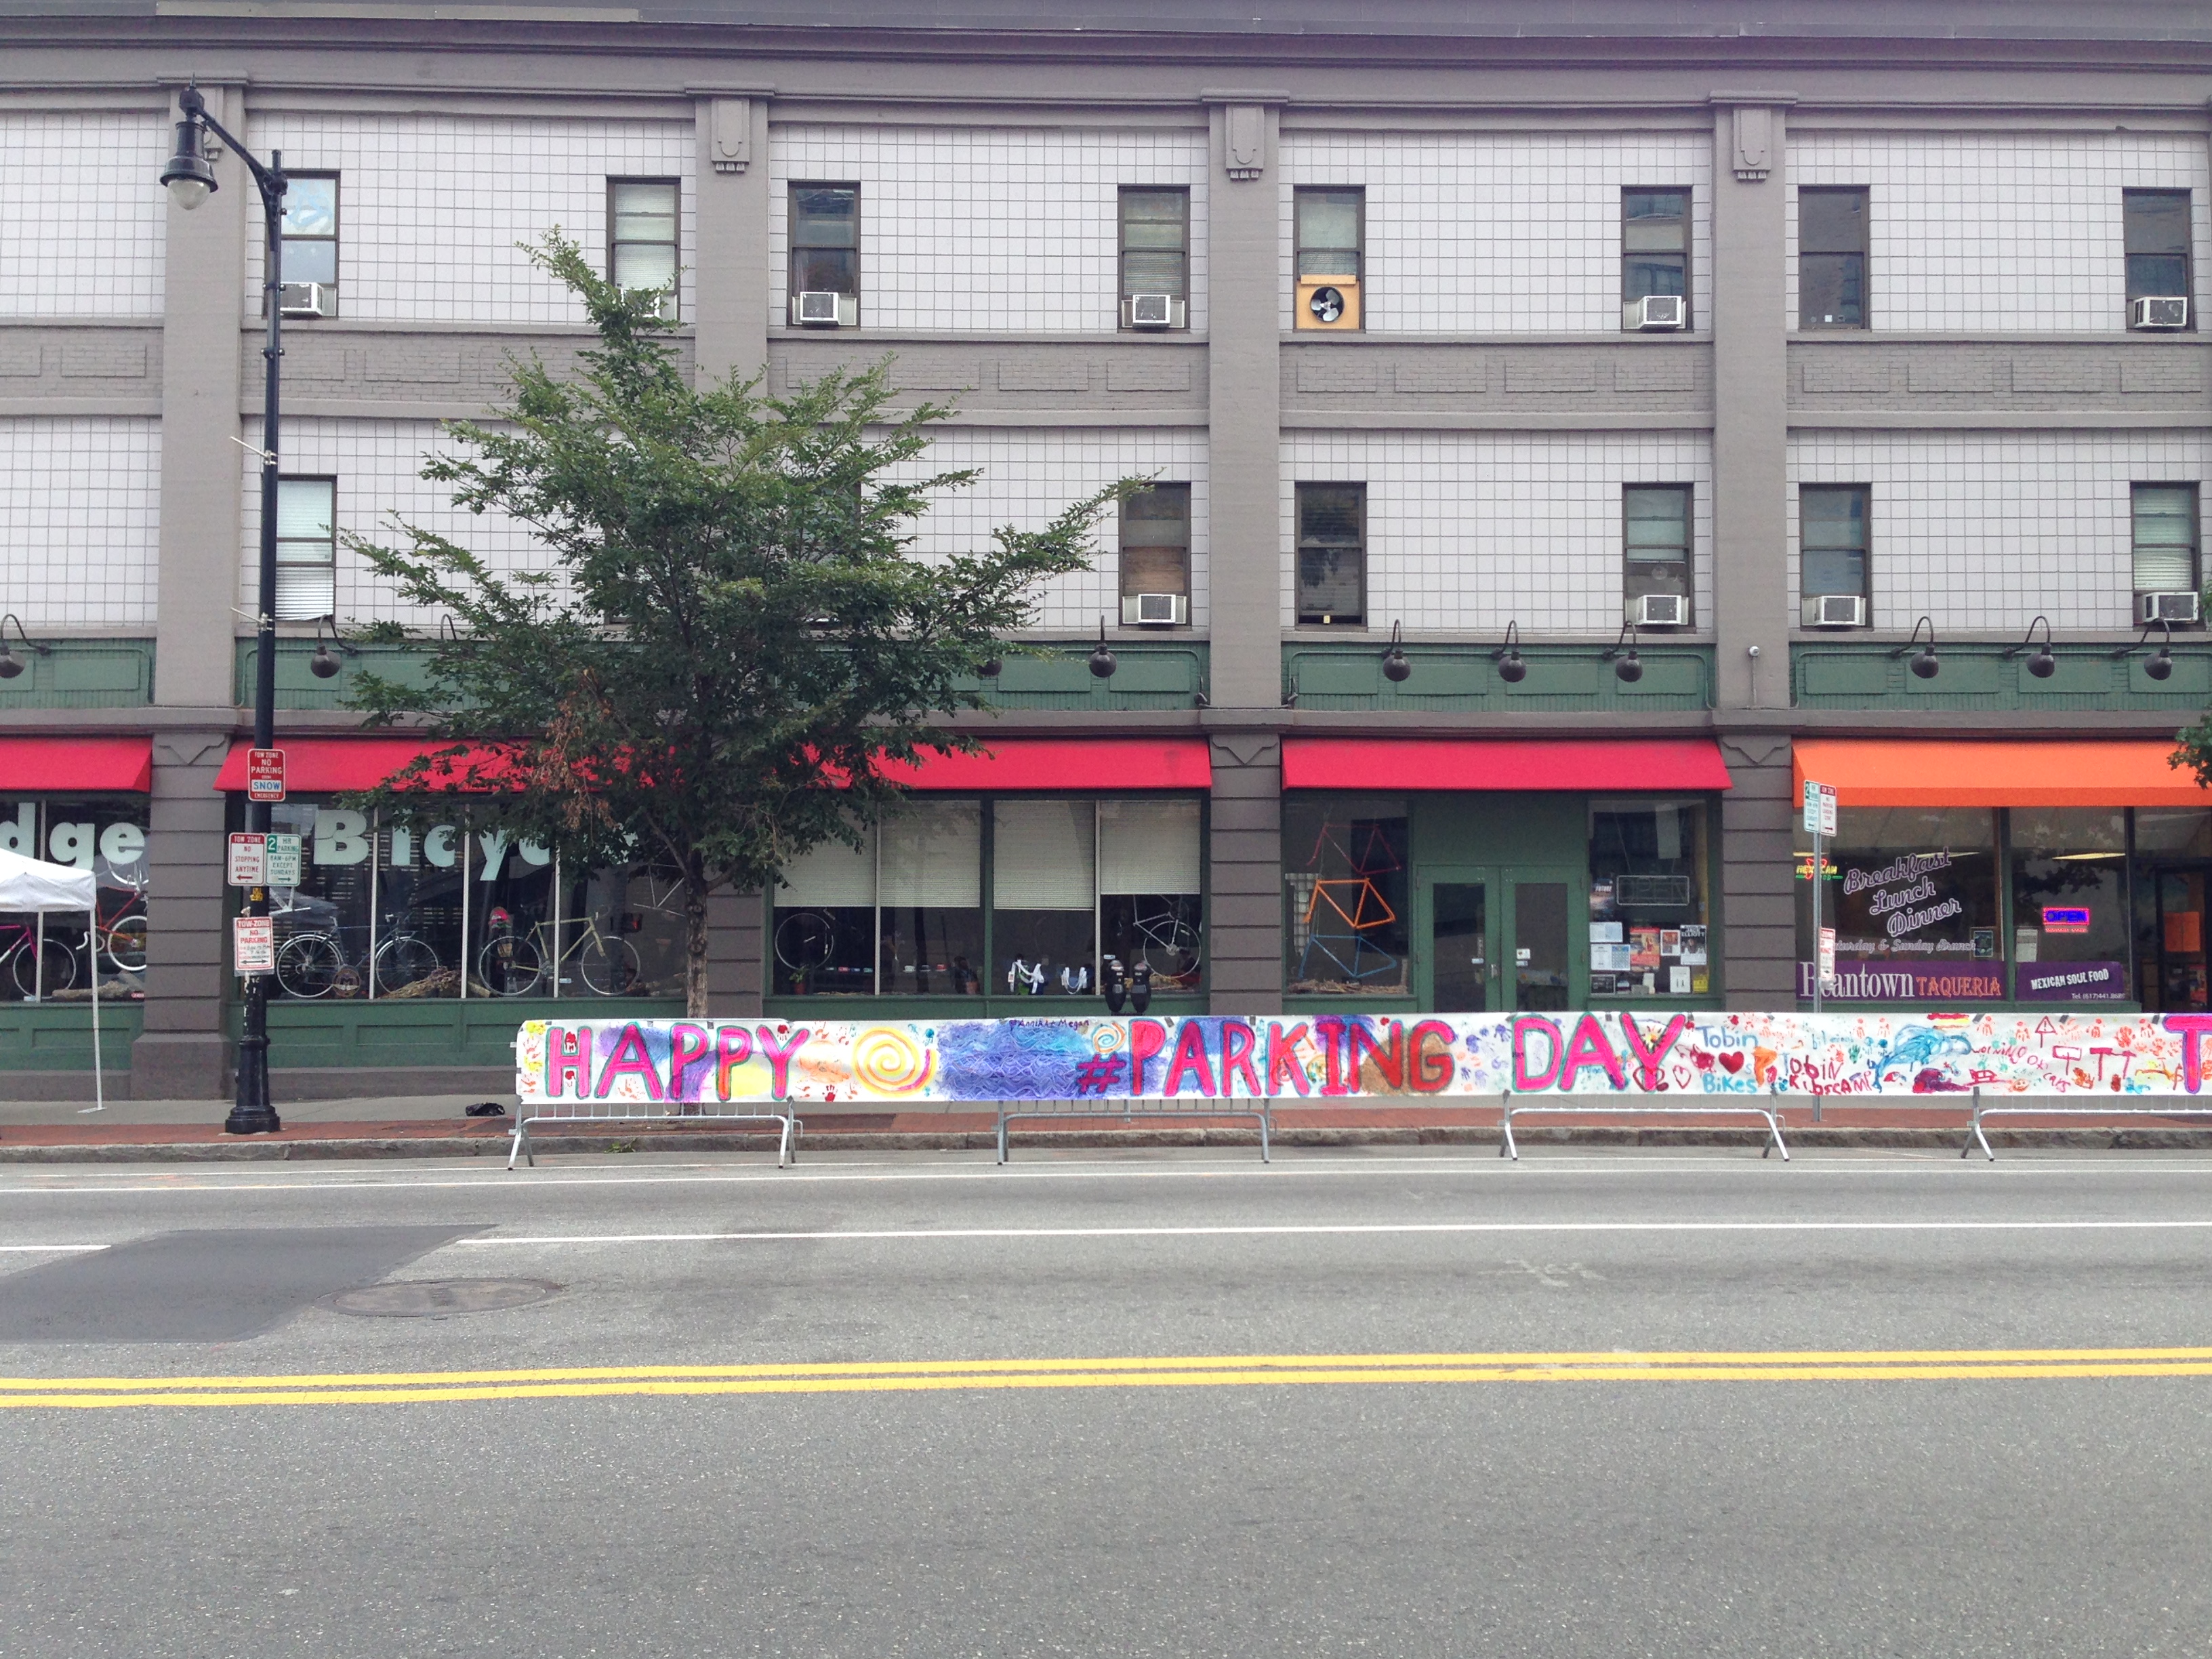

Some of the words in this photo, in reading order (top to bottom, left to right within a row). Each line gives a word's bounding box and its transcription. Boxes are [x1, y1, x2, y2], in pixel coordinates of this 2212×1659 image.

[253, 781, 280, 790] SNOW
[268, 837, 276, 851] 2
[1844, 846, 1952, 895] Breakfast
[1870, 876, 1936, 915] Lunch
[1887, 898, 1962, 937] Dinner
[2046, 910, 2086, 922] OPEN
[1892, 939, 1934, 954] Sunday
[1937, 939, 1976, 951] Brunch
[1916, 977, 2001, 998] TAQUERIA
[2031, 976, 2066, 989] MEXICAN
[2066, 972, 2087, 985] SOUL
[2088, 968, 2109, 982] FOOD
[1057, 1019, 1089, 1031] Megan
[1696, 1025, 1758, 1048] Tobin
[545, 1022, 812, 1101] HAPPY
[1511, 1012, 1687, 1092] DAY
